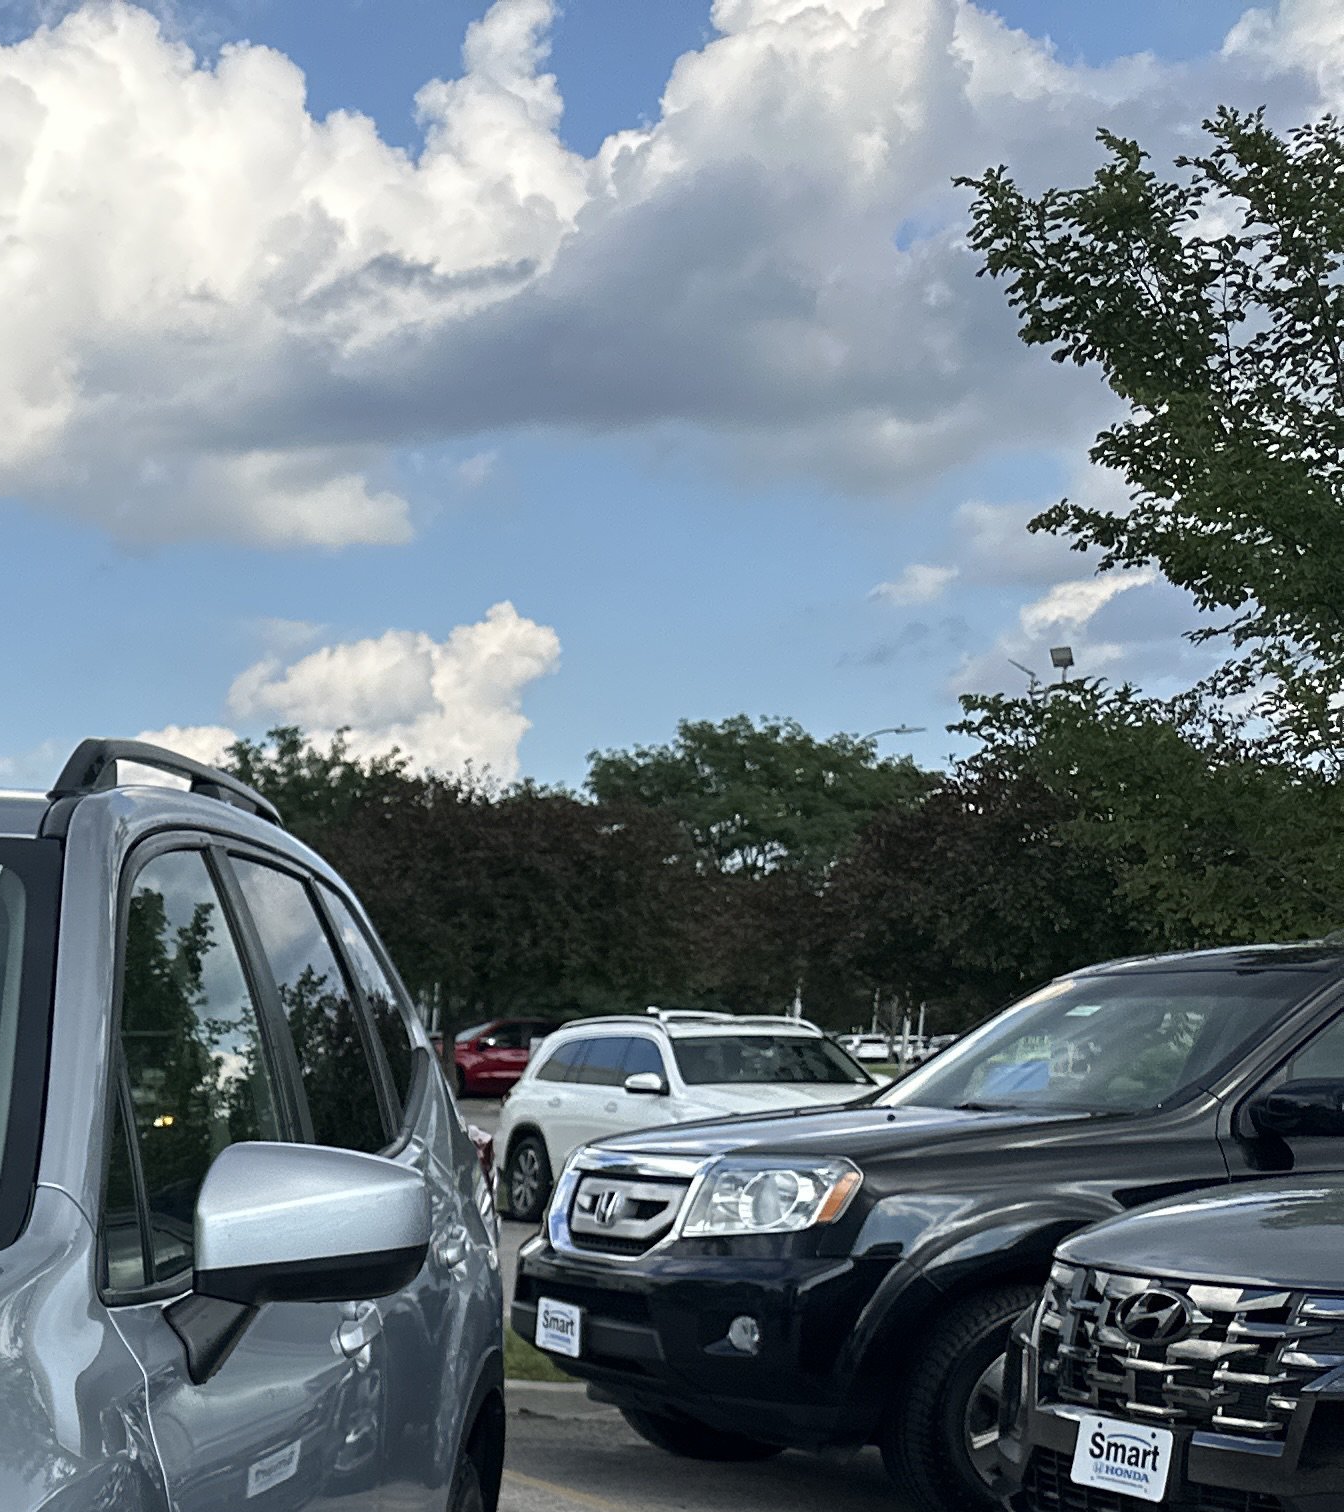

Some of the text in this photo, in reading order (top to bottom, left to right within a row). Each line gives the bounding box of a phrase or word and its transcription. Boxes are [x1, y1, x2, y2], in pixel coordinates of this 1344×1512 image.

[542, 1310, 574, 1336] Smart
[1089, 1432, 1159, 1471] Smart
[1105, 1465, 1149, 1483] HONDA
